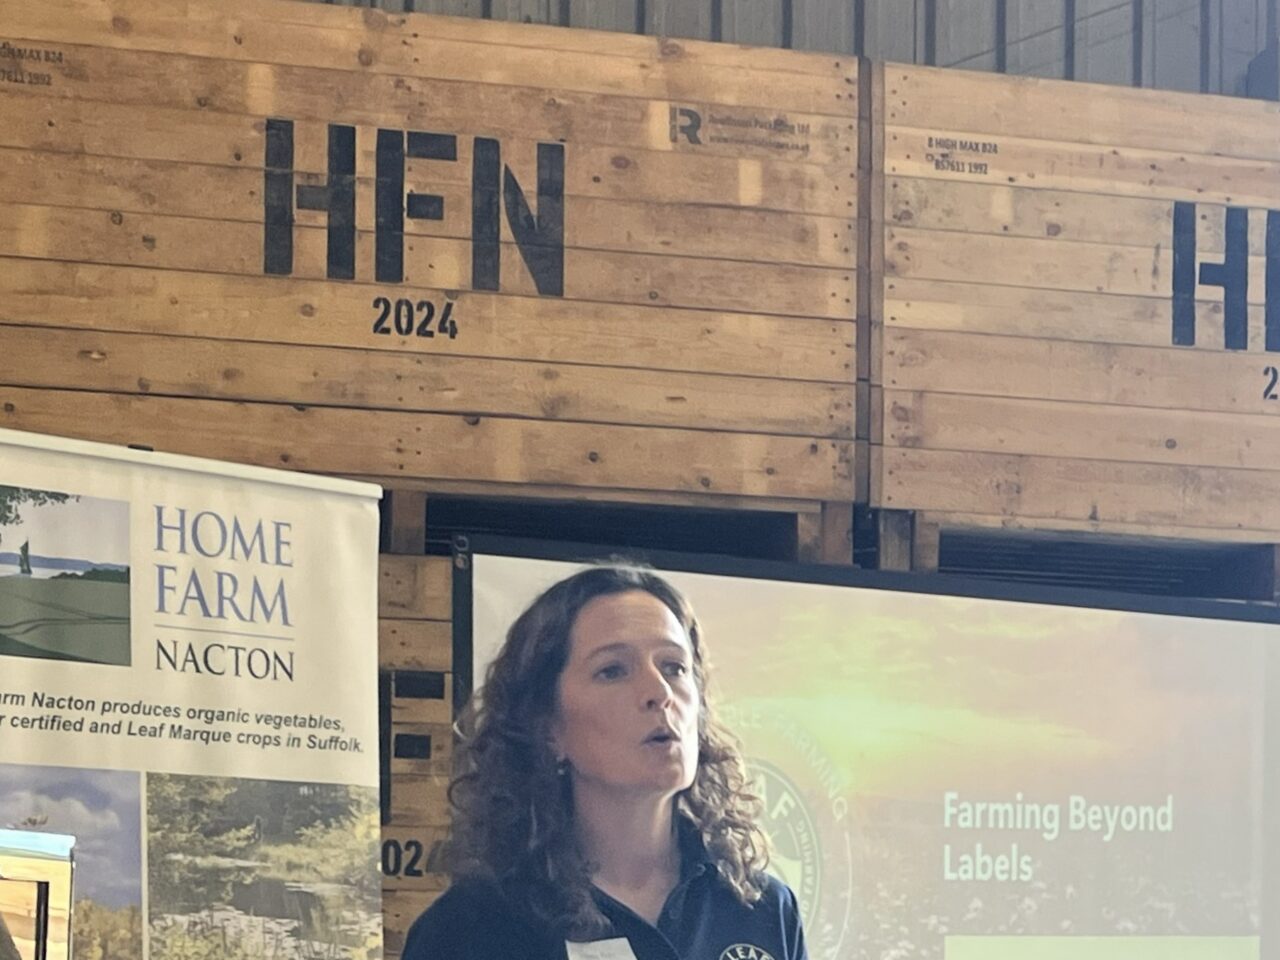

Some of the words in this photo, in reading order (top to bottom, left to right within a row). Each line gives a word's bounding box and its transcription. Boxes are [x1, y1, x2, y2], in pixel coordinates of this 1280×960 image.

[669, 106, 702, 145] R
[935, 138, 957, 151] HIGH
[959, 140, 981, 153] MAX
[263, 118, 565, 296] HFN
[373, 297, 458, 339] 2024
[153, 504, 294, 568] HOME
[154, 563, 295, 628] FARM
[155, 638, 295, 683] NACTON
[31, 691, 96, 711] Nacton
[100, 700, 181, 719] produces
[186, 707, 250, 724] organic
[254, 713, 345, 733] vegetables,
[10, 714, 85, 732] certified
[89, 721, 122, 735] and
[127, 720, 165, 738] Leaf
[169, 724, 232, 745] Marque
[237, 732, 281, 750] crops
[286, 732, 302, 748] in
[306, 734, 364, 753] Suffolk.
[943, 791, 1060, 840] Farming
[1068, 794, 1174, 841] Beyond
[382, 839, 424, 878] 02
[943, 844, 1034, 883] Labels
